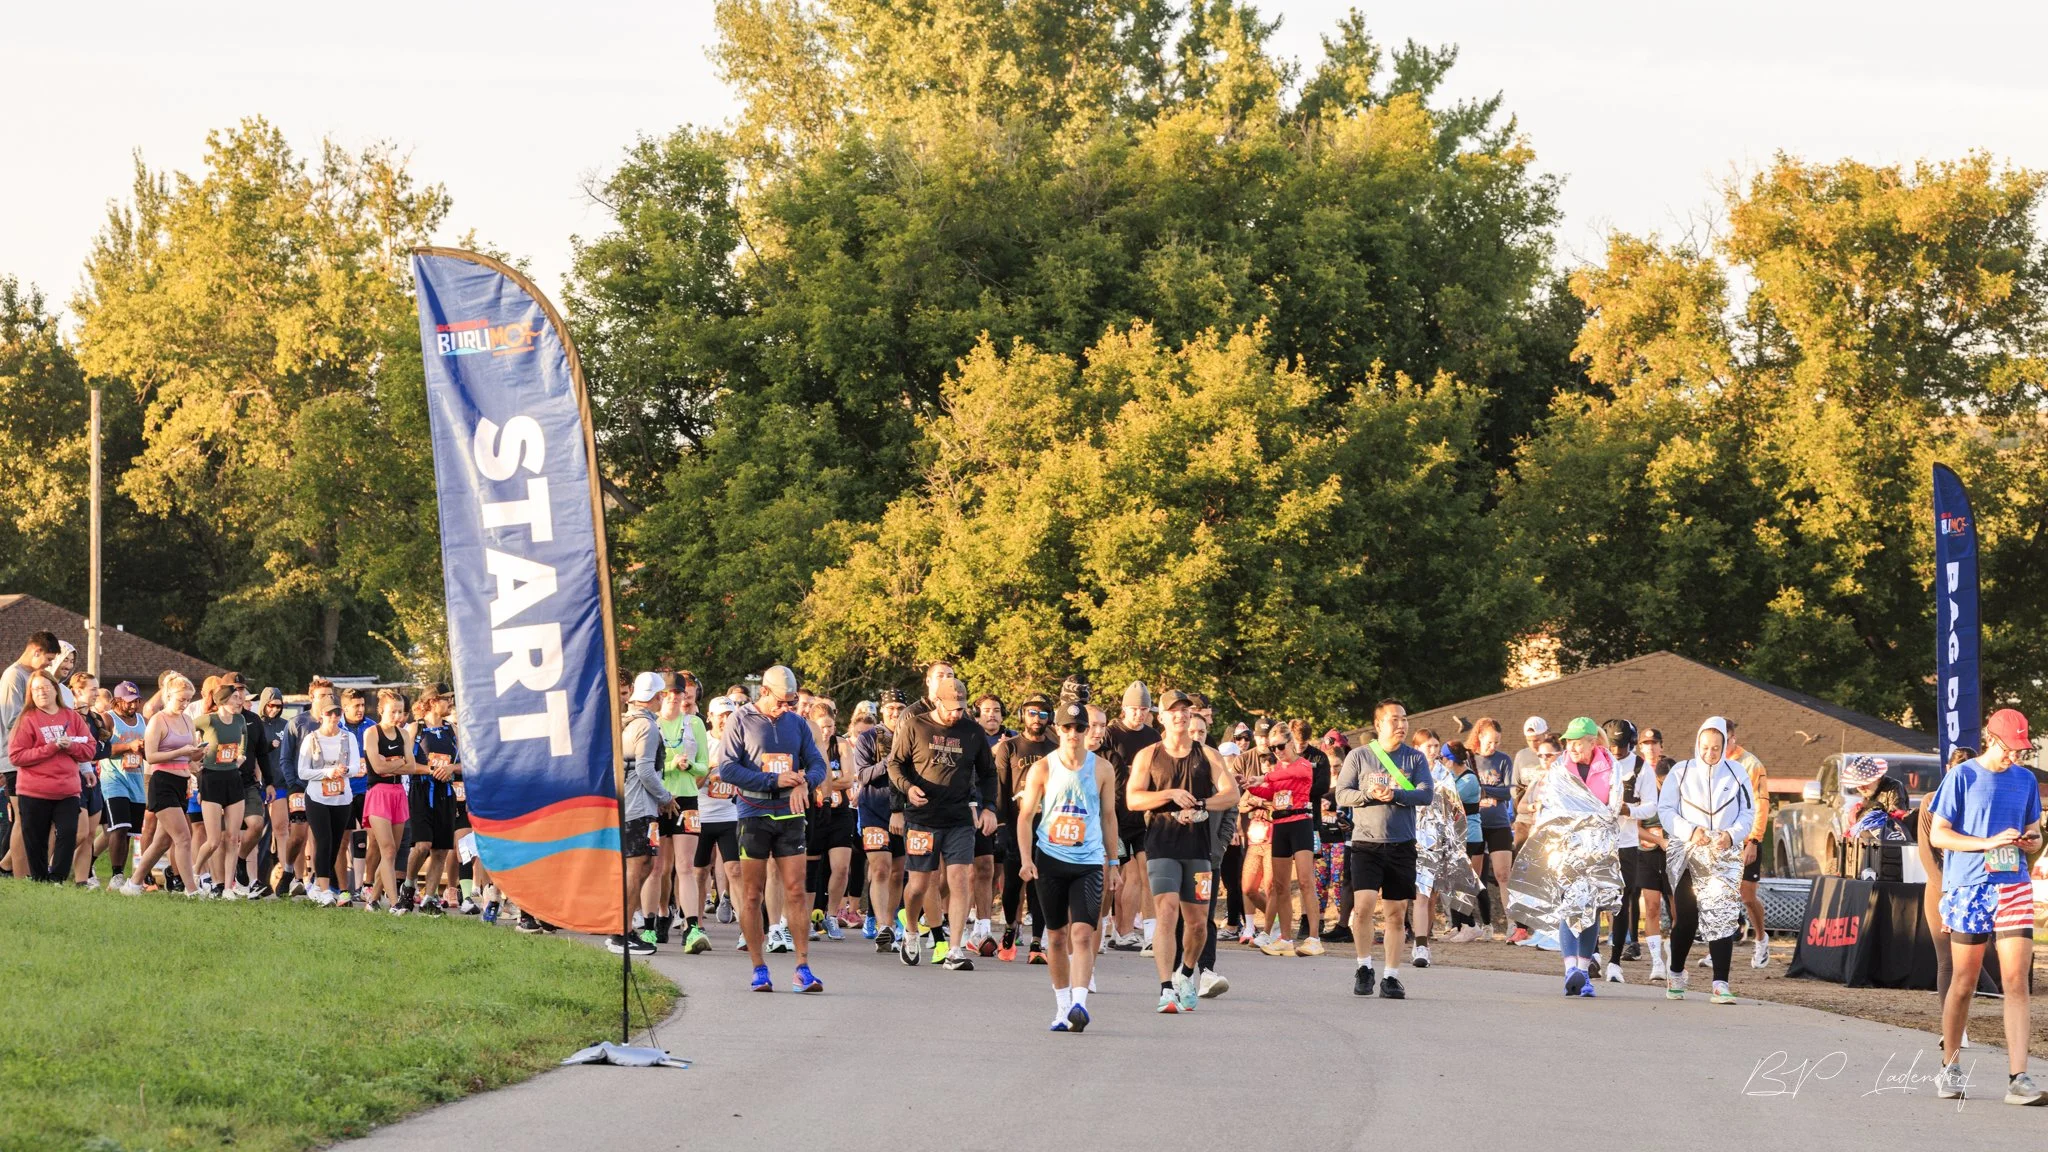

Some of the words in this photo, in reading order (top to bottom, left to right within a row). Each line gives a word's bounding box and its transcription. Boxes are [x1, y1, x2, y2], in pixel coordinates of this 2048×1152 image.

[474, 415, 573, 757] START
[1946, 562, 1960, 665] BAG
[221, 749, 235, 759] 167
[767, 760, 789, 773] 105
[326, 781, 342, 792] 161
[712, 782, 732, 795] 208
[1055, 823, 1080, 840] 143
[866, 833, 884, 845] 213
[909, 837, 928, 850] 152
[1990, 847, 2016, 865] 305
[1807, 915, 1860, 947] SCHEELS
